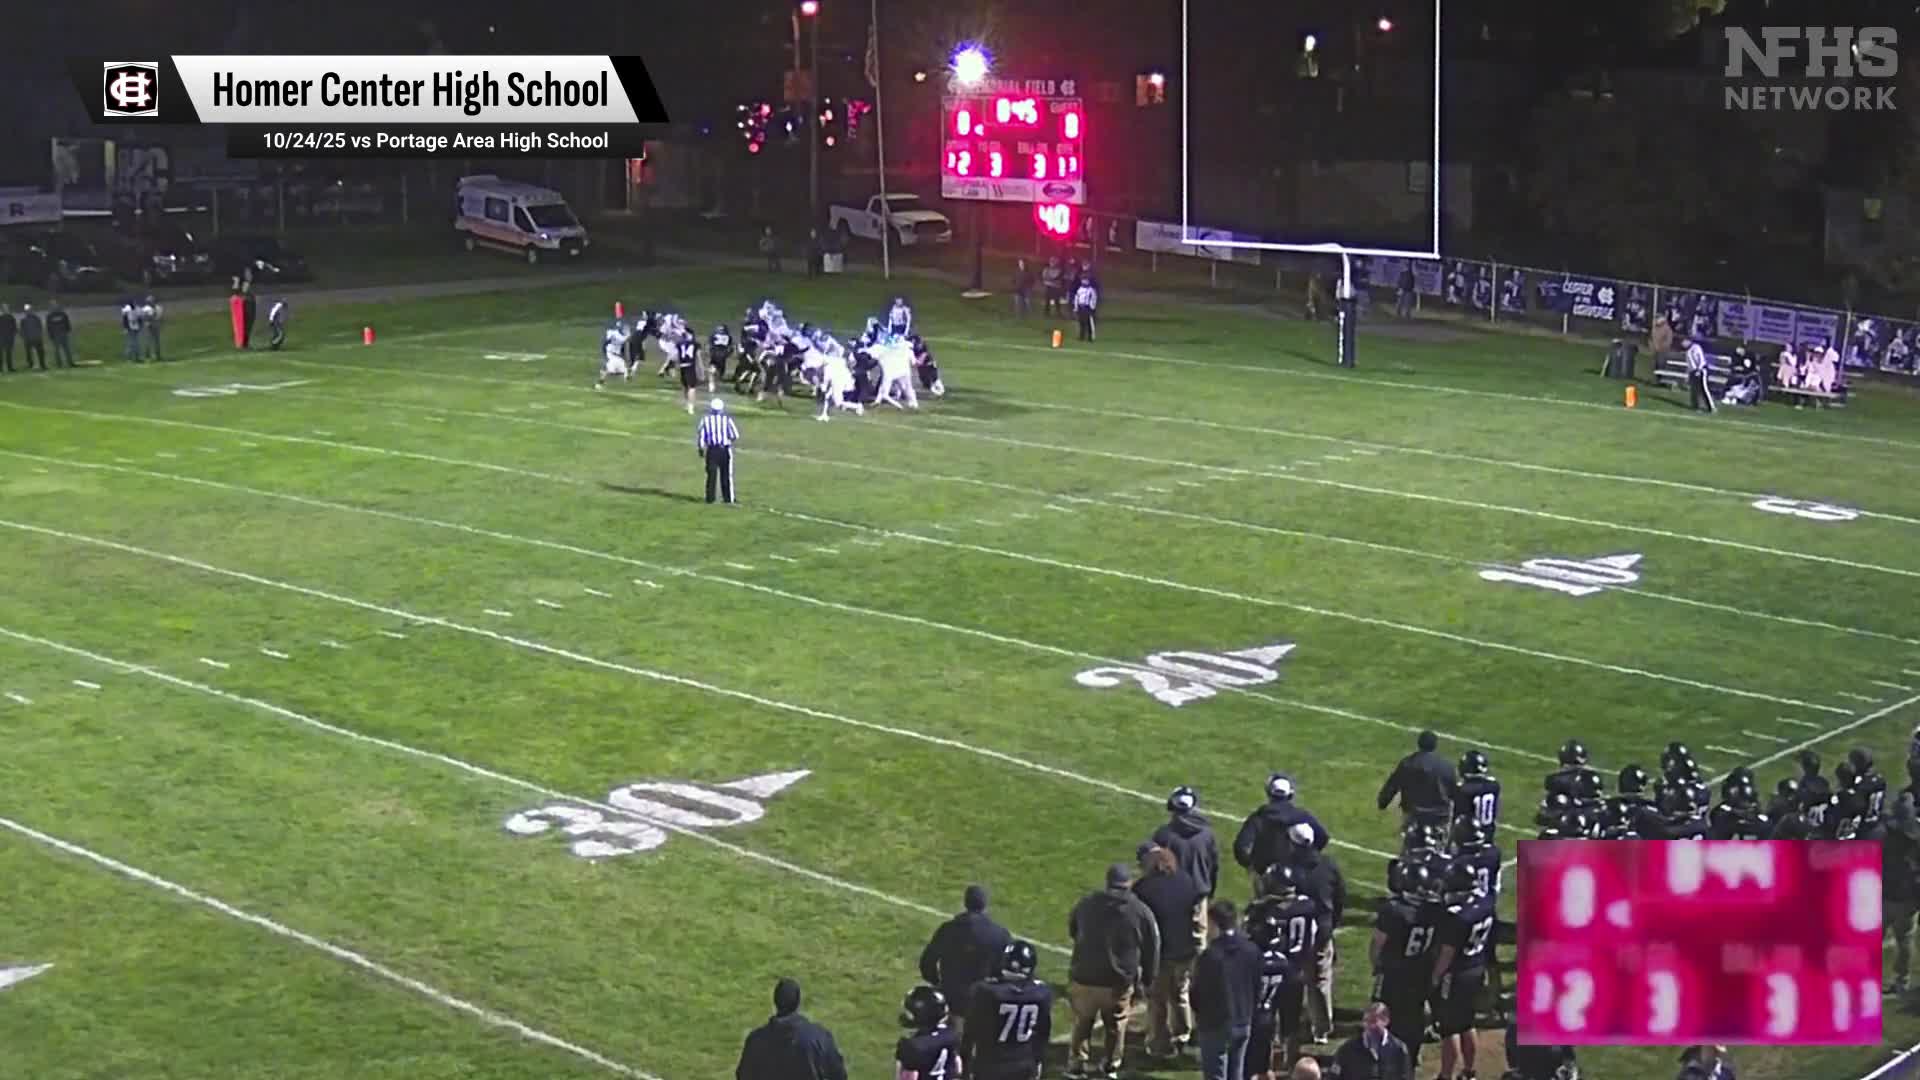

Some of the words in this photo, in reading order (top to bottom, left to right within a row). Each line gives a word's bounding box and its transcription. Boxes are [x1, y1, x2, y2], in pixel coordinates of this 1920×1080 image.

[1024, 79, 1055, 95] FIELD
[1038, 203, 1070, 234] 40
[1074, 651, 1279, 707] 20
[505, 782, 764, 857] 30
[1473, 793, 1495, 825] 10
[1405, 927, 1434, 956] 61
[999, 1003, 1039, 1042] 70
[930, 1048, 948, 1080] 4
